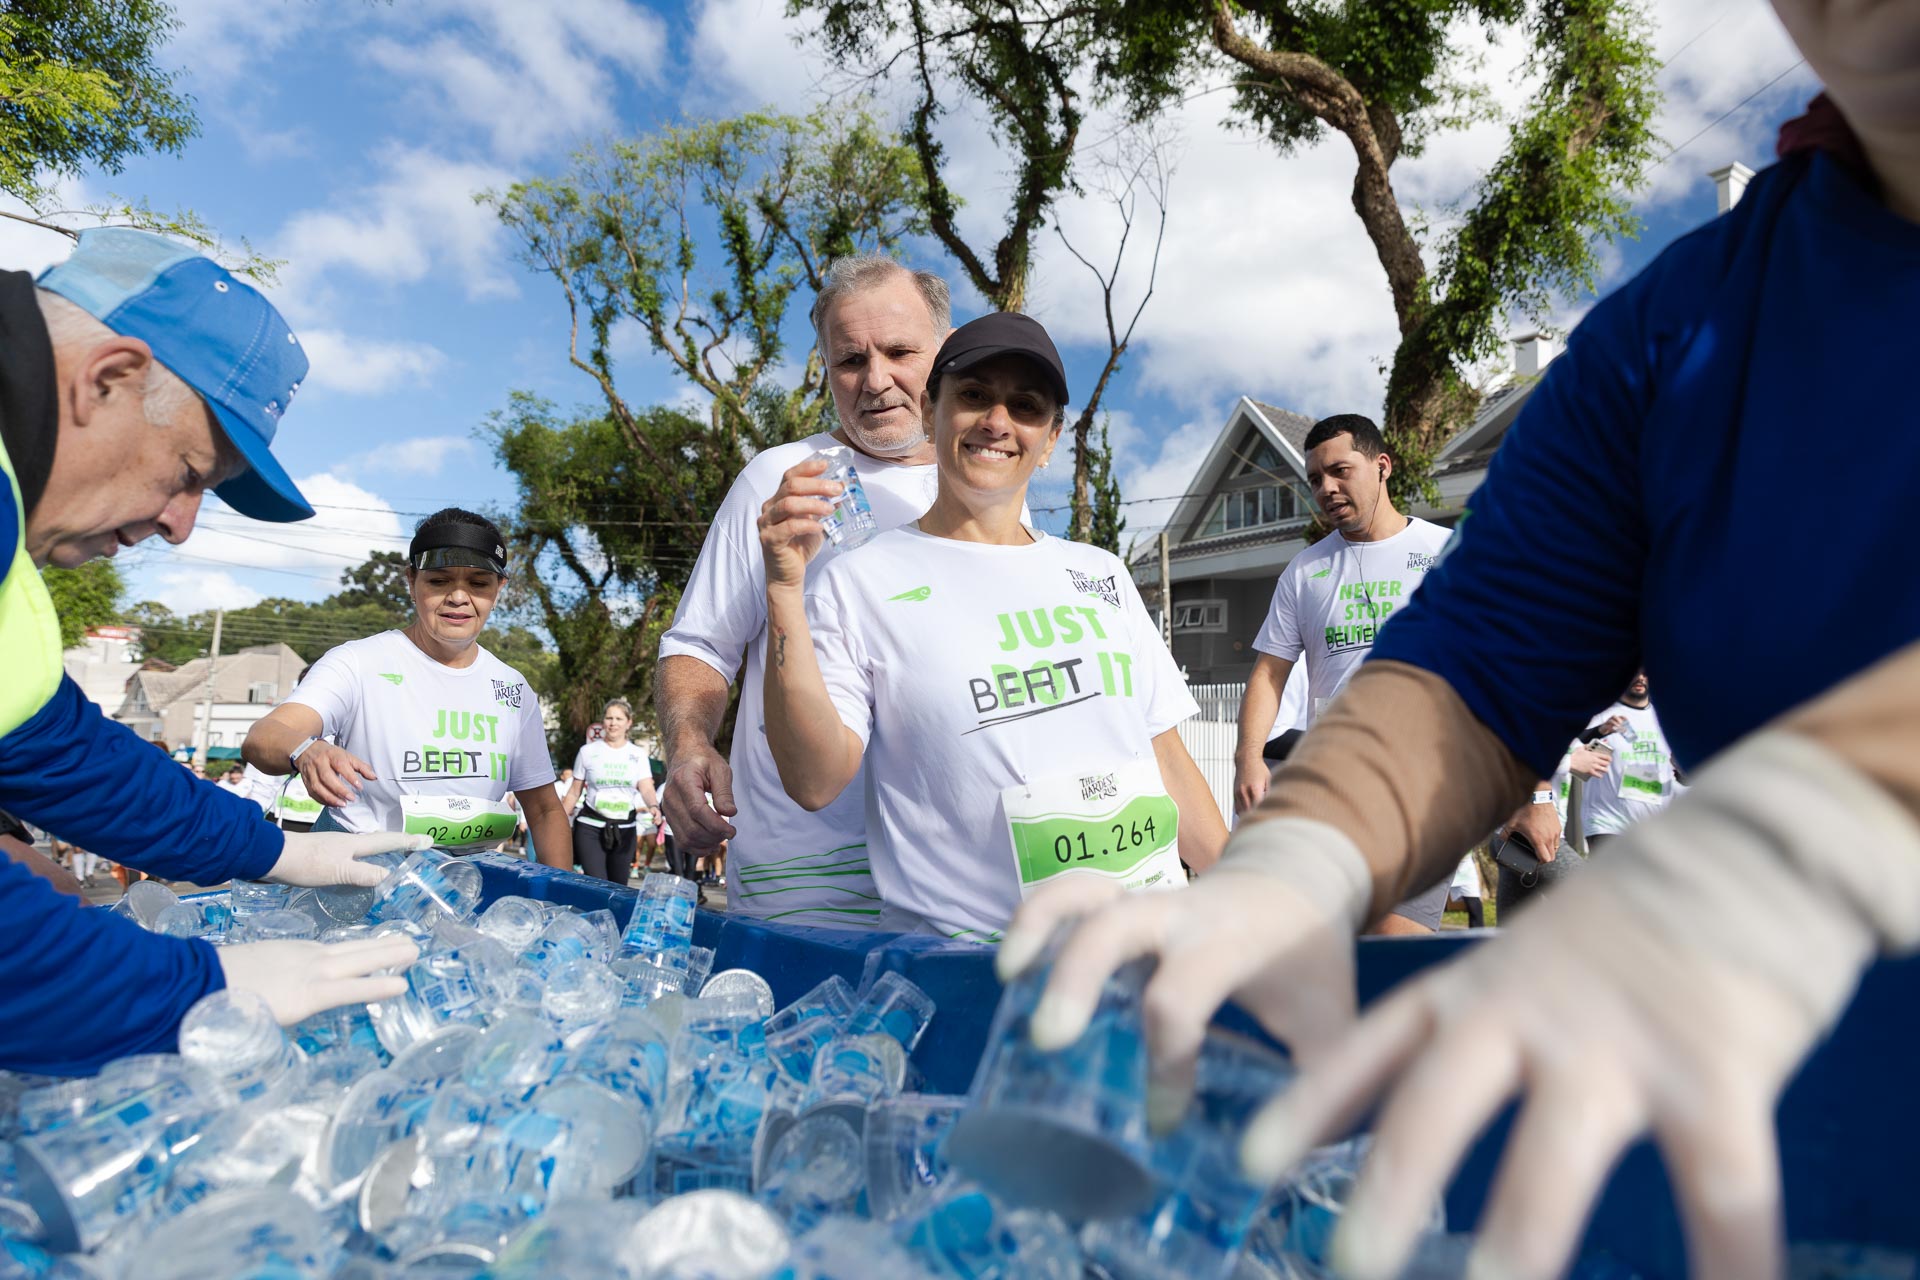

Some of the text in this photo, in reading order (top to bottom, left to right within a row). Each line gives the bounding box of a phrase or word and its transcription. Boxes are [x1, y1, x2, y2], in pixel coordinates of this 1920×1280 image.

[1407, 556, 1440, 569] HARDES
[1408, 552, 1423, 560] THE
[1065, 568, 1088, 580] THE
[1072, 575, 1116, 593] HARDEST
[1339, 580, 1402, 600] NEVER
[1100, 592, 1121, 609] RUN
[1344, 601, 1394, 620] STOP
[996, 605, 1108, 651] JUST
[491, 679, 505, 689] THE
[968, 652, 1133, 714] BEAT IT
[432, 710, 499, 744] JUST
[403, 751, 507, 781] BEAT IT
[1079, 776, 1095, 788] THE
[1081, 772, 1115, 800] HARDEST
[1099, 785, 1118, 800] RUN
[426, 824, 494, 842] 02.096
[1054, 815, 1156, 863] 01.264
